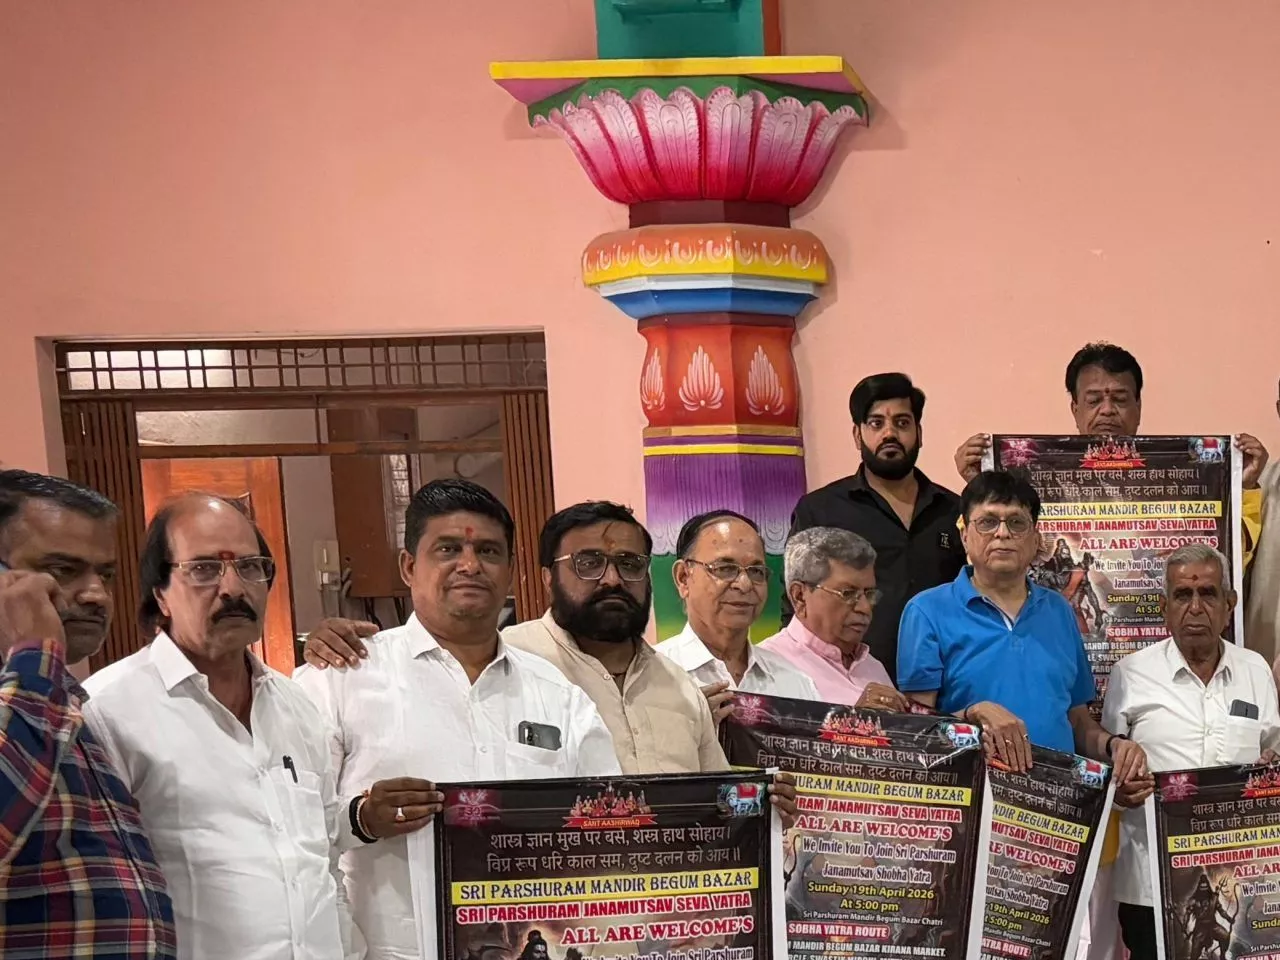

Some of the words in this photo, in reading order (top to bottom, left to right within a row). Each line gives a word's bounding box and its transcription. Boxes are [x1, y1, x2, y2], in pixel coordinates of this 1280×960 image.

[1039, 505, 1096, 516] ARSHURAM
[1099, 504, 1138, 515] MANDIR
[1141, 503, 1176, 514] BEGUM
[1179, 502, 1215, 513] BAZAR
[1109, 627, 1138, 636] SOBHA
[1141, 627, 1166, 635] YATRA
[796, 815, 826, 831] ALL
[830, 819, 862, 834] ARE
[864, 821, 953, 841] WELCOME'S
[992, 804, 1016, 819] NDIR
[1016, 810, 1050, 829] BEGUM
[1050, 819, 1085, 839] BAZAR
[1174, 837, 1190, 849] SRI
[1192, 830, 1258, 847] PARSHURAM
[460, 884, 485, 900] SRI
[490, 880, 586, 899] PARSHURAM
[590, 877, 645, 894] MANDIR
[650, 874, 698, 890] BEGUM
[702, 871, 752, 887] BAZAR
[807, 881, 849, 894] Sunday
[852, 884, 876, 895] 19th
[878, 886, 905, 898] April
[908, 888, 934, 899] 2026
[457, 907, 485, 924] SRI
[487, 902, 579, 922] PARSHURAM
[582, 896, 673, 917] JANAMUTSAV
[676, 894, 711, 911] SEVA
[713, 891, 751, 909] YATRA
[840, 898, 852, 908] At
[855, 899, 879, 909] 5:00
[881, 903, 899, 913] pm
[988, 901, 1008, 914] 19th
[1008, 907, 1029, 921] April
[1030, 912, 1050, 924] 2026
[561, 927, 599, 945] ALL
[604, 924, 644, 942] ARE
[649, 916, 753, 939] WELCOME'S
[787, 922, 823, 934] SOBHA
[824, 924, 852, 935] YATRA
[854, 926, 887, 937] ROUTE
